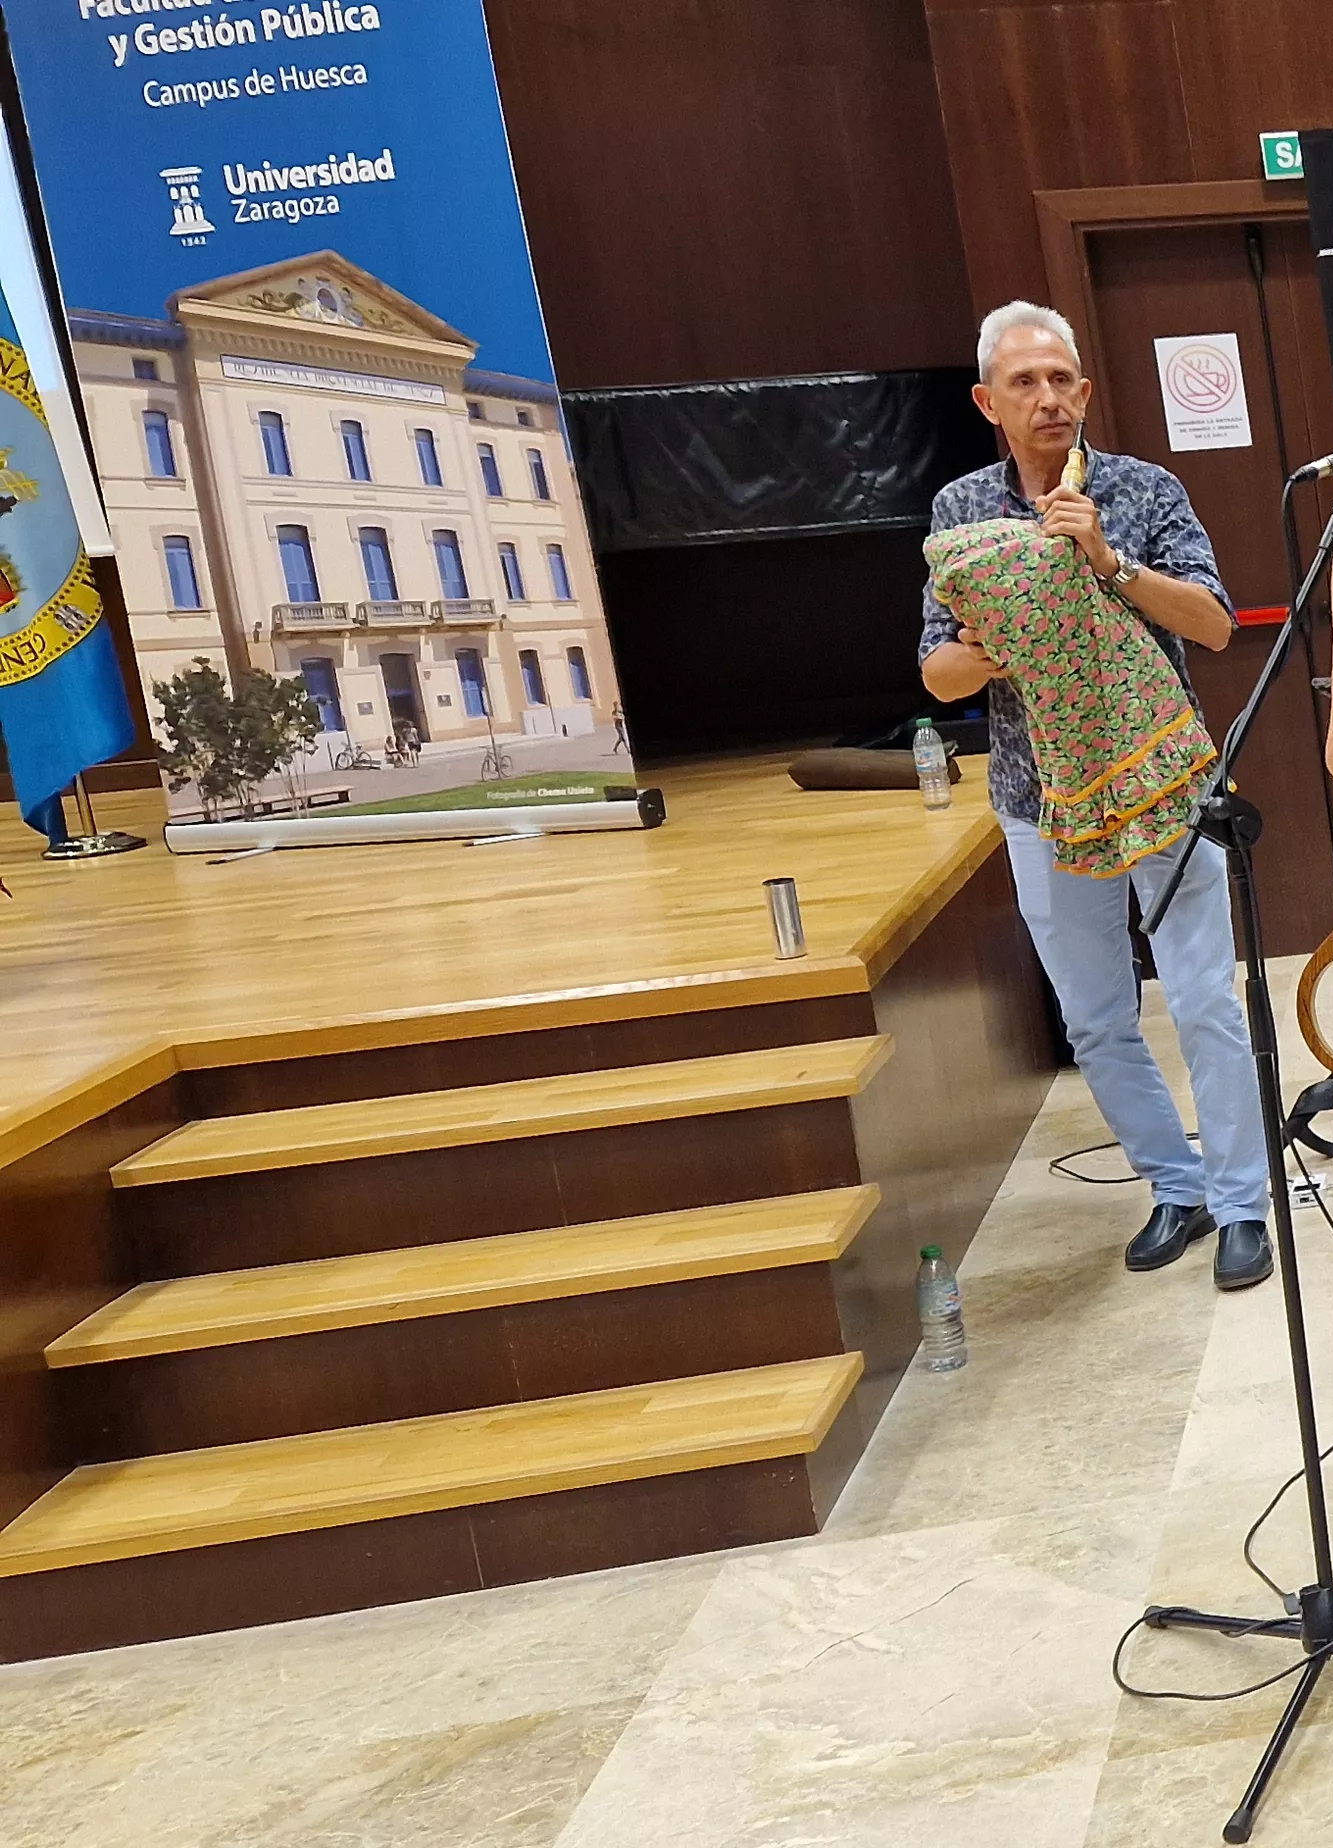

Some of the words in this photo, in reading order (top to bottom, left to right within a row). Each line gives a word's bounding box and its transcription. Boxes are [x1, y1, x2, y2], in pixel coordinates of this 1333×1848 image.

[108, 33, 128, 67] y
[134, 13, 257, 55] Gestión
[260, 0, 381, 41] Pública
[142, 75, 241, 108] Campus
[244, 68, 276, 96] de
[279, 63, 368, 92] Huesca
[222, 148, 397, 195] Universidad
[230, 194, 341, 224] Zaragoza
